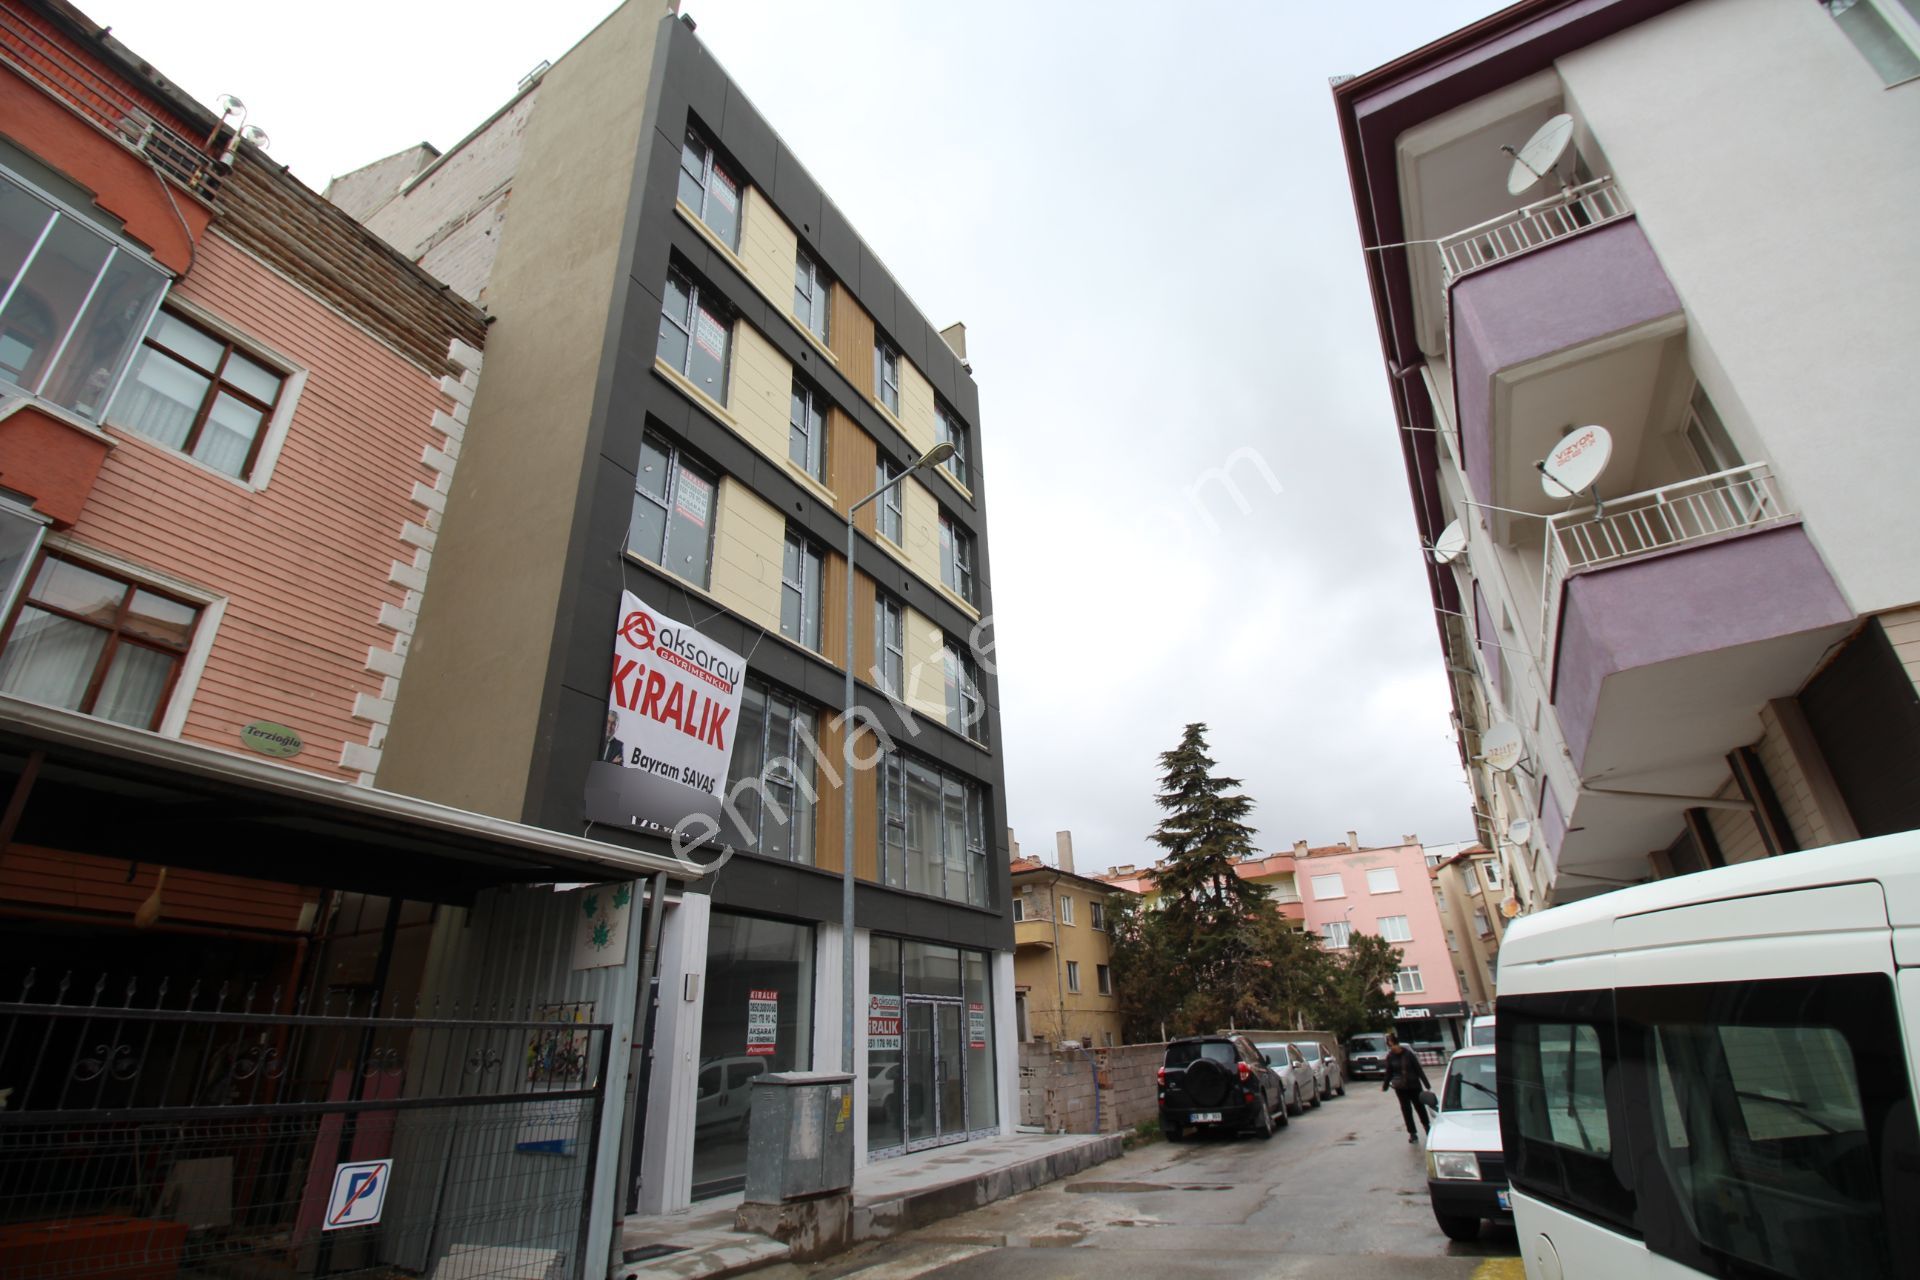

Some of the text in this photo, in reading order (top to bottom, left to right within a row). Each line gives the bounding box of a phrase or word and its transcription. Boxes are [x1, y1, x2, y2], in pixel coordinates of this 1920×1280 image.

[660, 628, 740, 694] aksaray
[247, 726, 301, 748] Terzioğlu
[631, 747, 680, 780] Bayram
